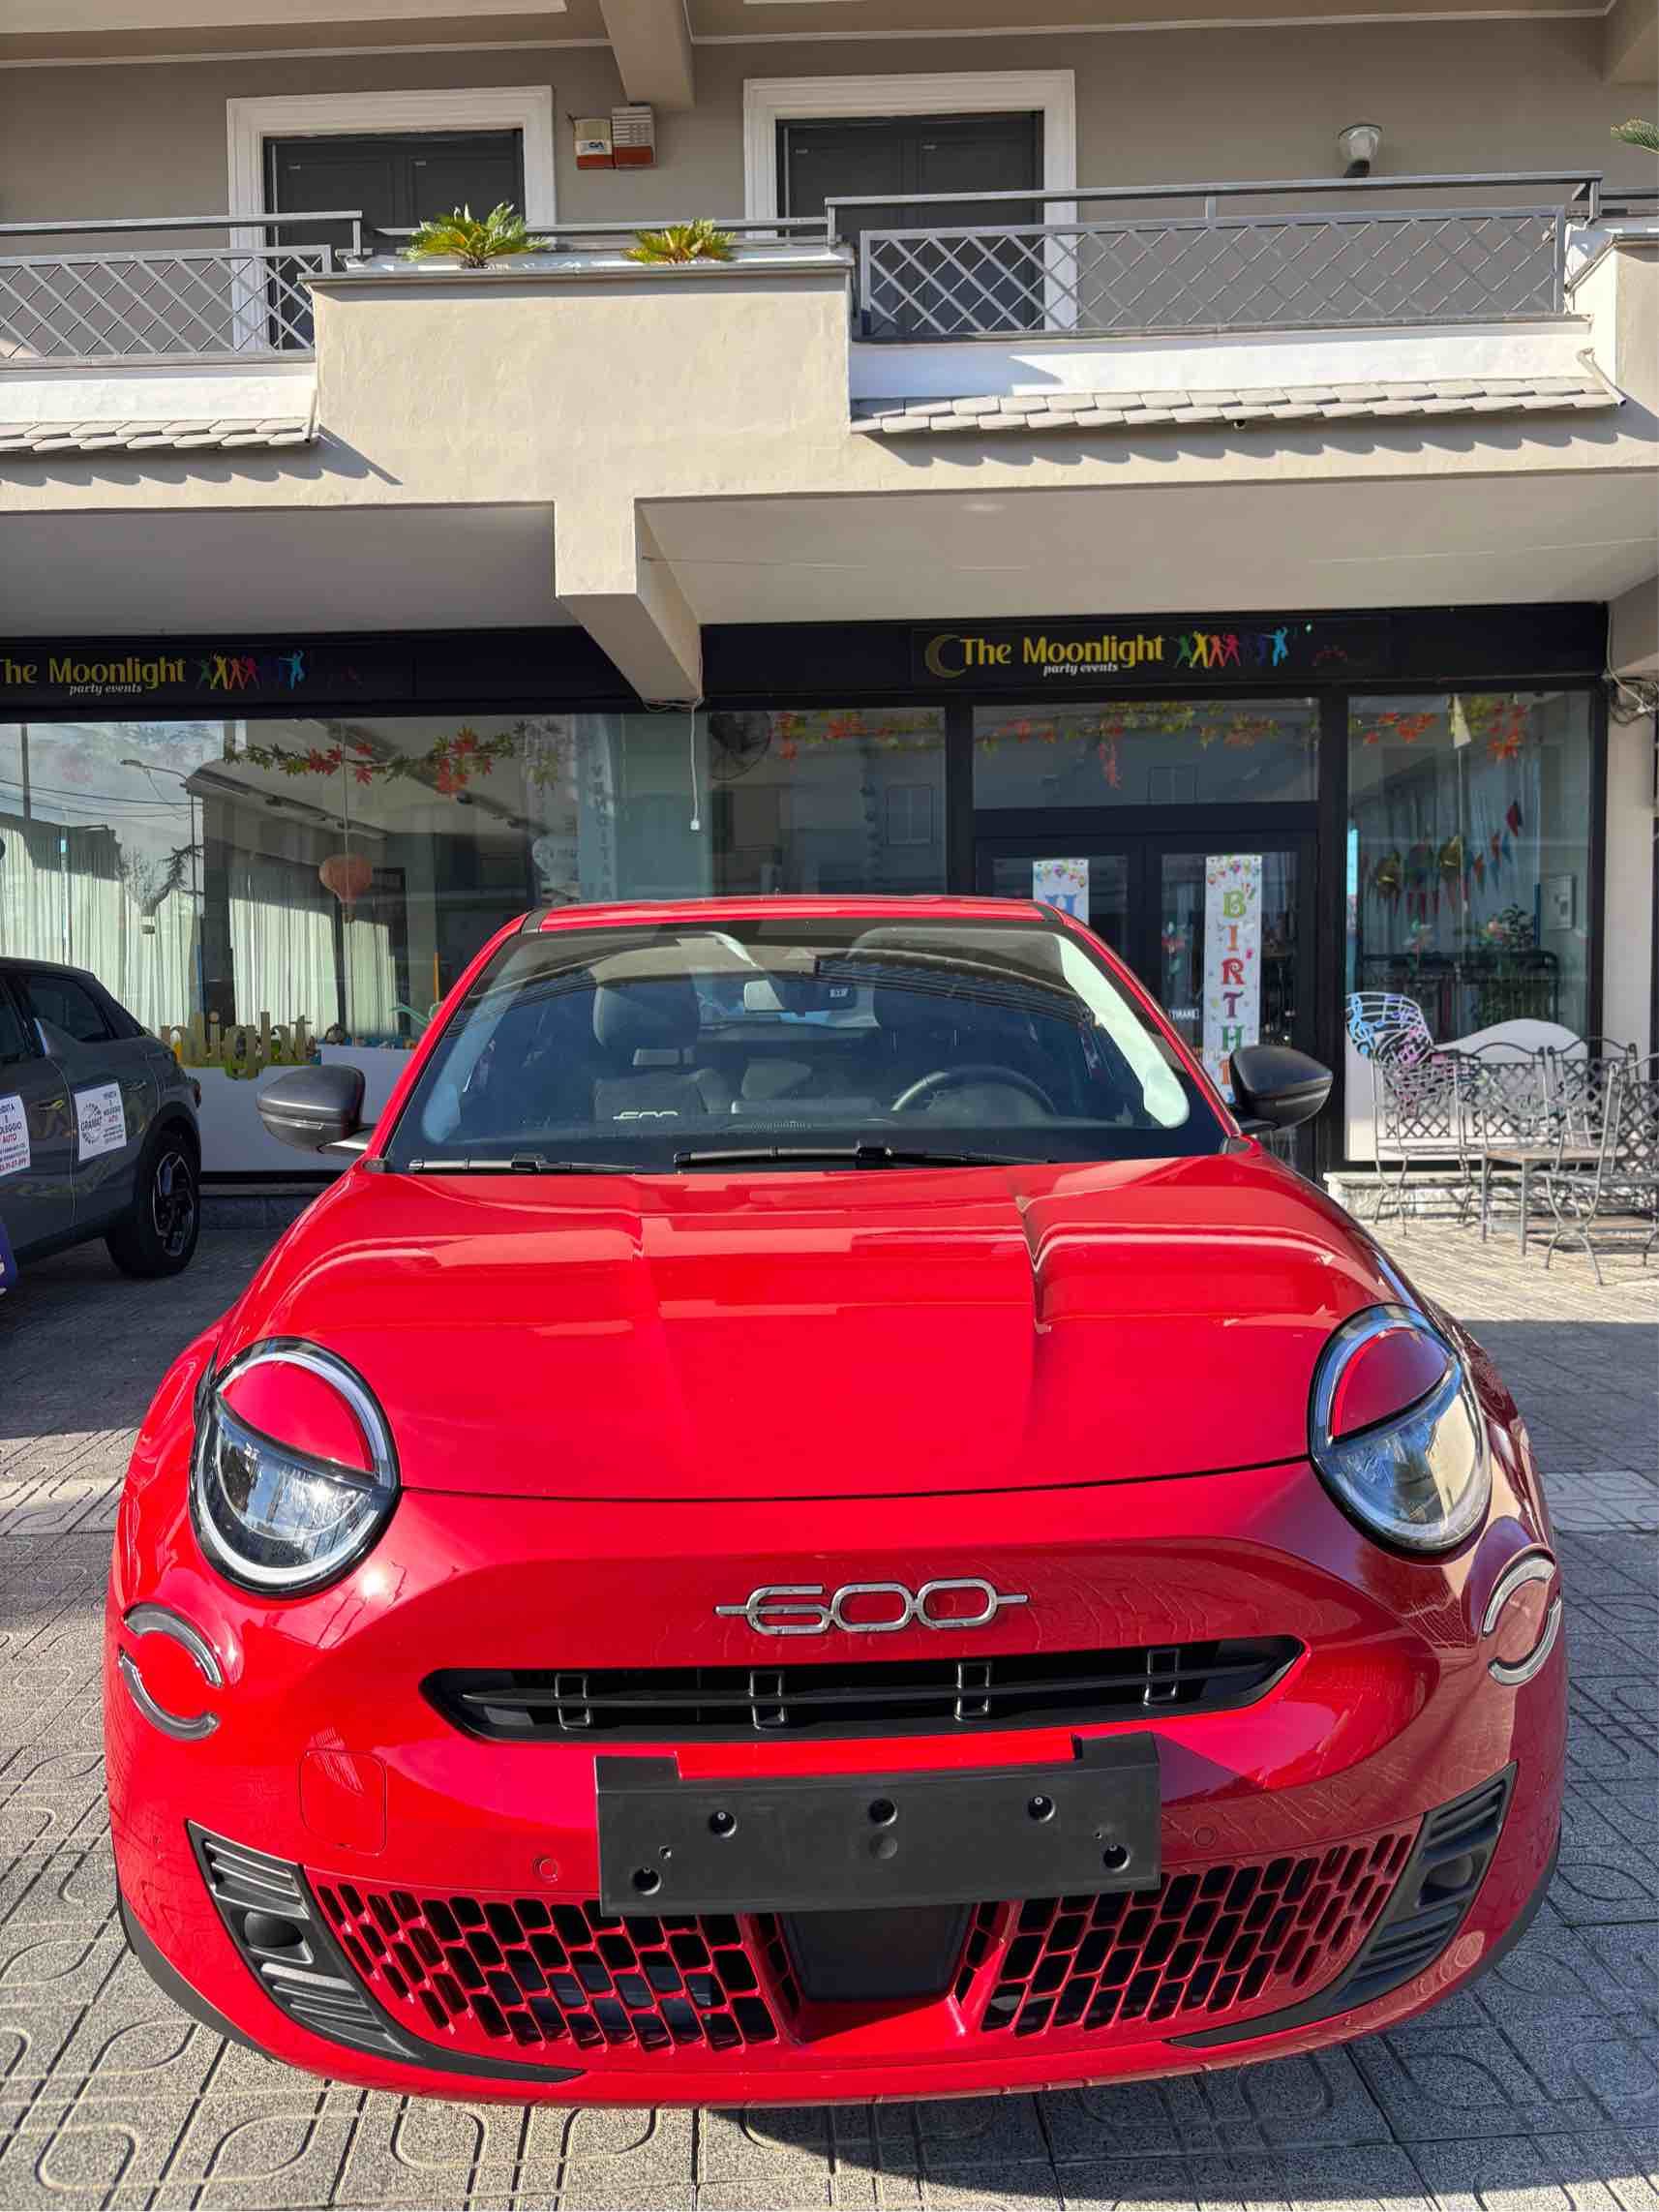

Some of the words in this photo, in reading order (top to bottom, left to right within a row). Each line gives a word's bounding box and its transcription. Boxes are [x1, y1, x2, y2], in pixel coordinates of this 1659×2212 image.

[960, 638, 1011, 666] The
[1023, 634, 1165, 668] Moonlight
[0, 658, 38, 683] he
[49, 657, 186, 689] Moonlight
[1043, 663, 1078, 677] party
[1079, 661, 1119, 673] events
[70, 683, 102, 696] party
[106, 682, 142, 694] events
[1221, 891, 1247, 1104] BIRTH
[161, 1011, 313, 1080] nlight
[744, 1577, 998, 1636] 600
